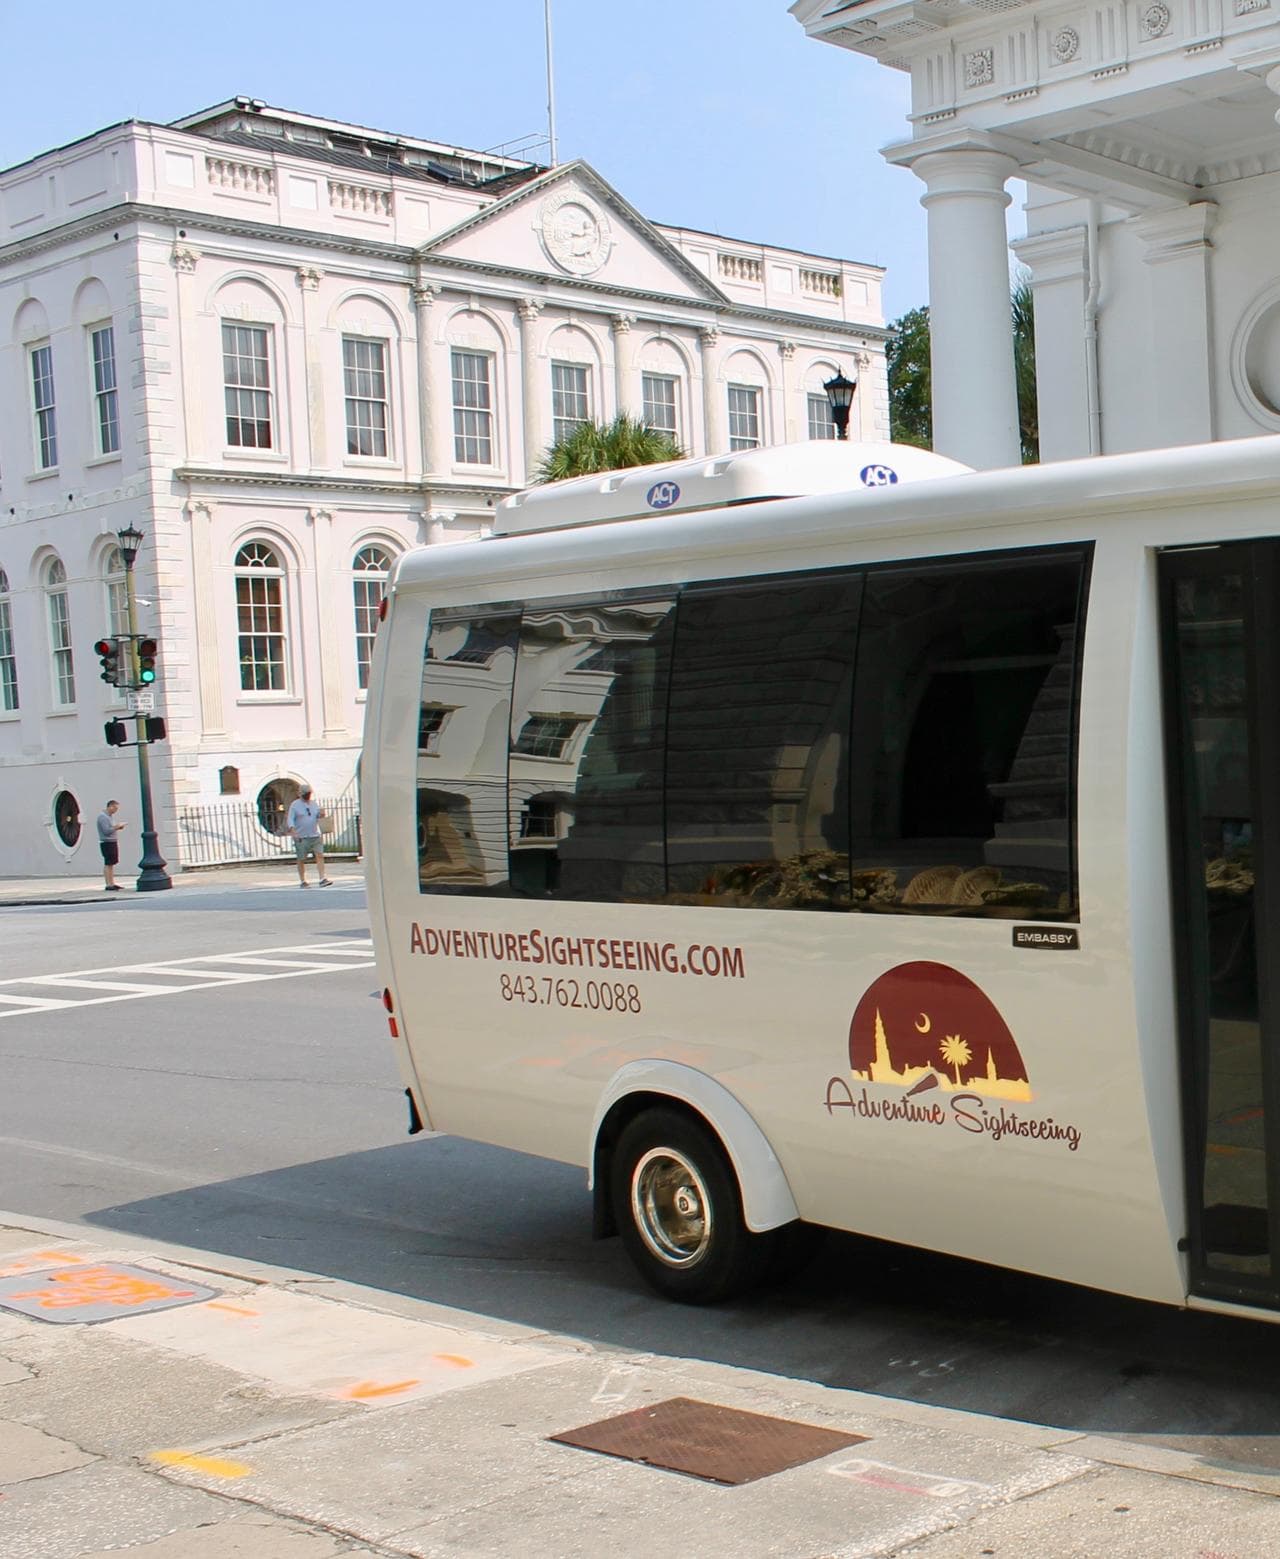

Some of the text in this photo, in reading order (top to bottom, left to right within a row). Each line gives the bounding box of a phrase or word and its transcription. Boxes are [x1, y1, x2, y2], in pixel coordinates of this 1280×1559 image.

[651, 483, 676, 505] ACT
[1017, 933, 1073, 944] EMBASSY
[499, 974, 641, 1013] 843.762.0088
[823, 1076, 1081, 1151] Adventure Sightseeing
